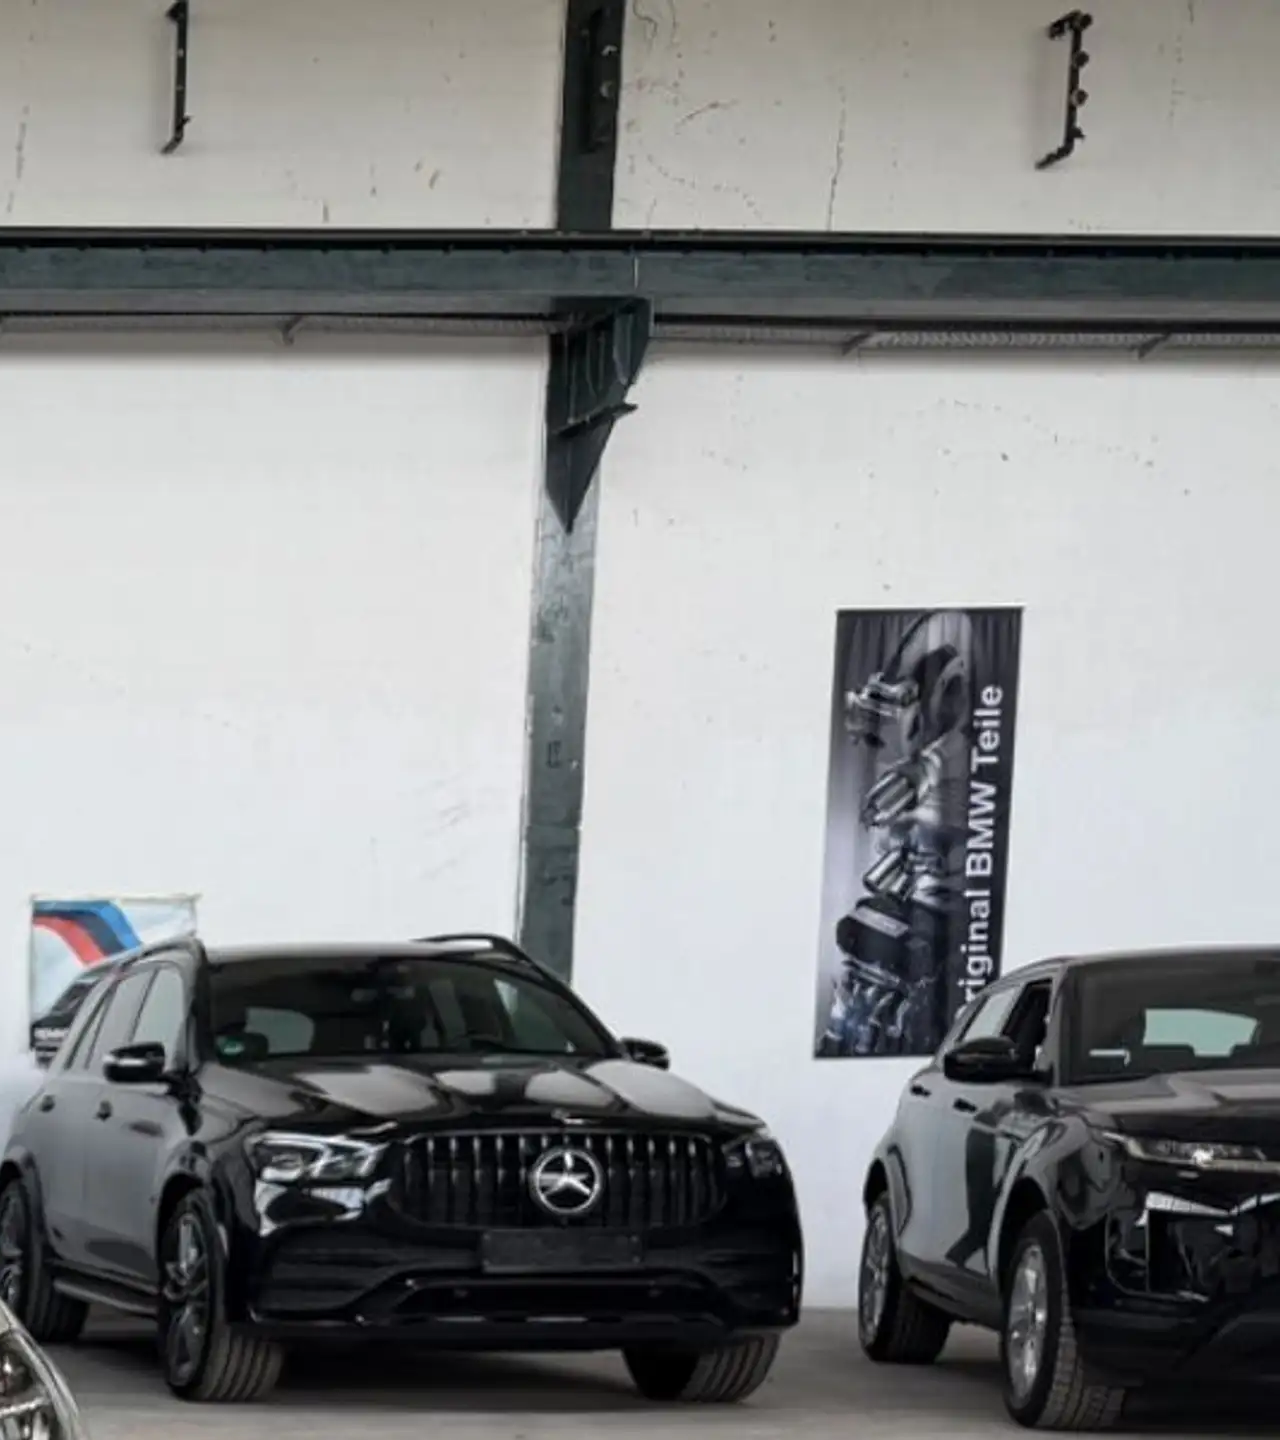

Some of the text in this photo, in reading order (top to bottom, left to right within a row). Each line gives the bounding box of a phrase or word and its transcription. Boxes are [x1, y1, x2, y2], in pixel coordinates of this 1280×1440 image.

[956, 685, 1004, 1016] riginal BMW Teile
